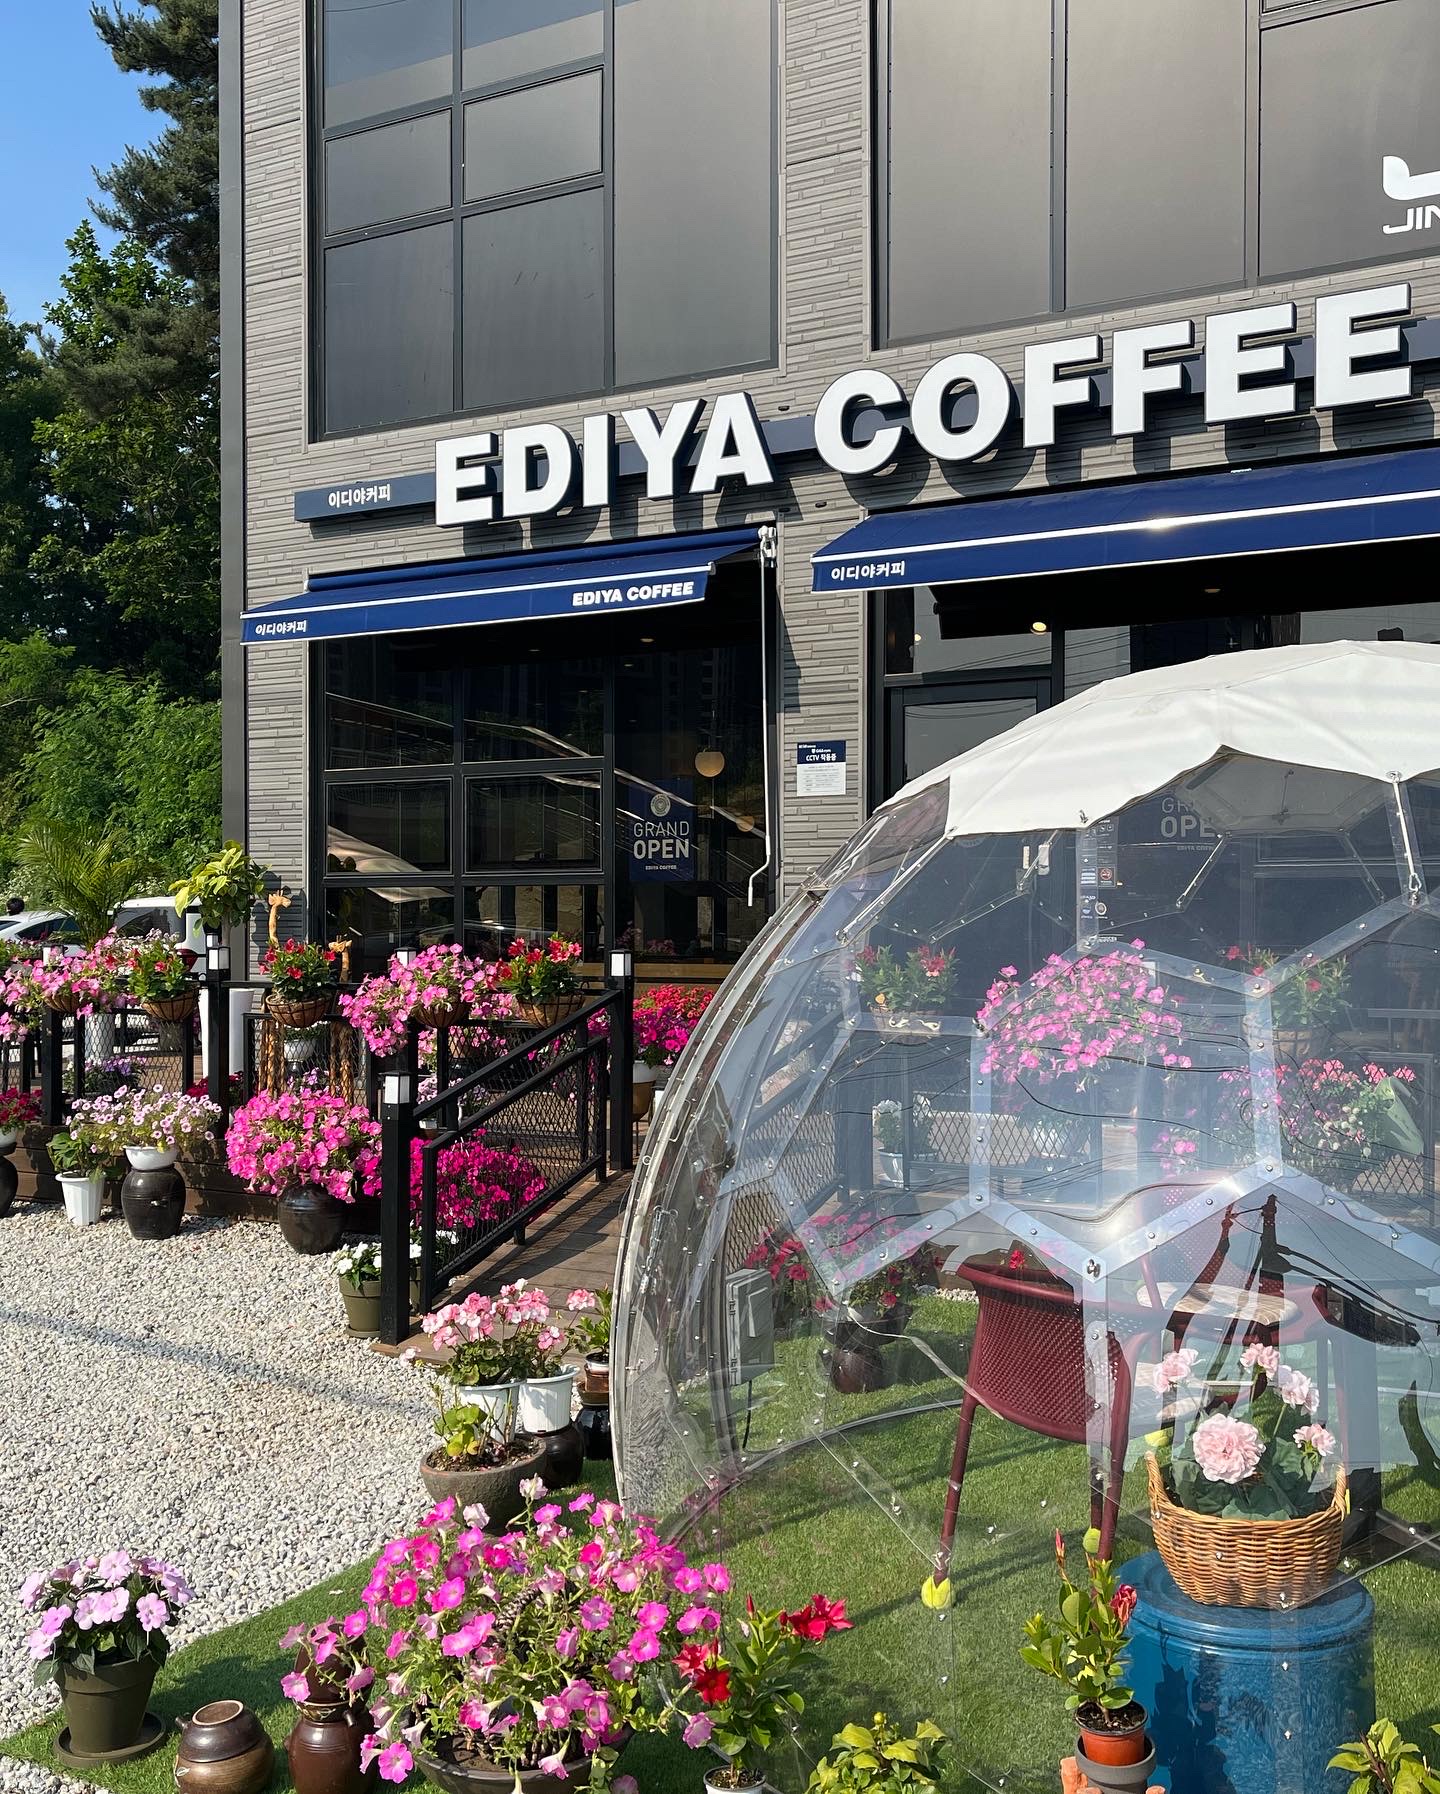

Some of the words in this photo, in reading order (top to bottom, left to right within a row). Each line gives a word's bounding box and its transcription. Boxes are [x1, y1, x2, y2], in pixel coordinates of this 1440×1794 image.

[435, 391, 777, 528] EDIYA
[813, 282, 1414, 477] COFFEE
[328, 483, 391, 508] 이디야커피
[831, 560, 906, 581] 이디야커피
[572, 588, 623, 607] EDIYA
[626, 581, 695, 601] COFFEE
[255, 620, 307, 636] 이디야커피
[805, 754, 820, 762] CCTV
[633, 821, 690, 838] GRAND
[1160, 814, 1217, 838] OPE
[633, 838, 690, 860] OPEN
